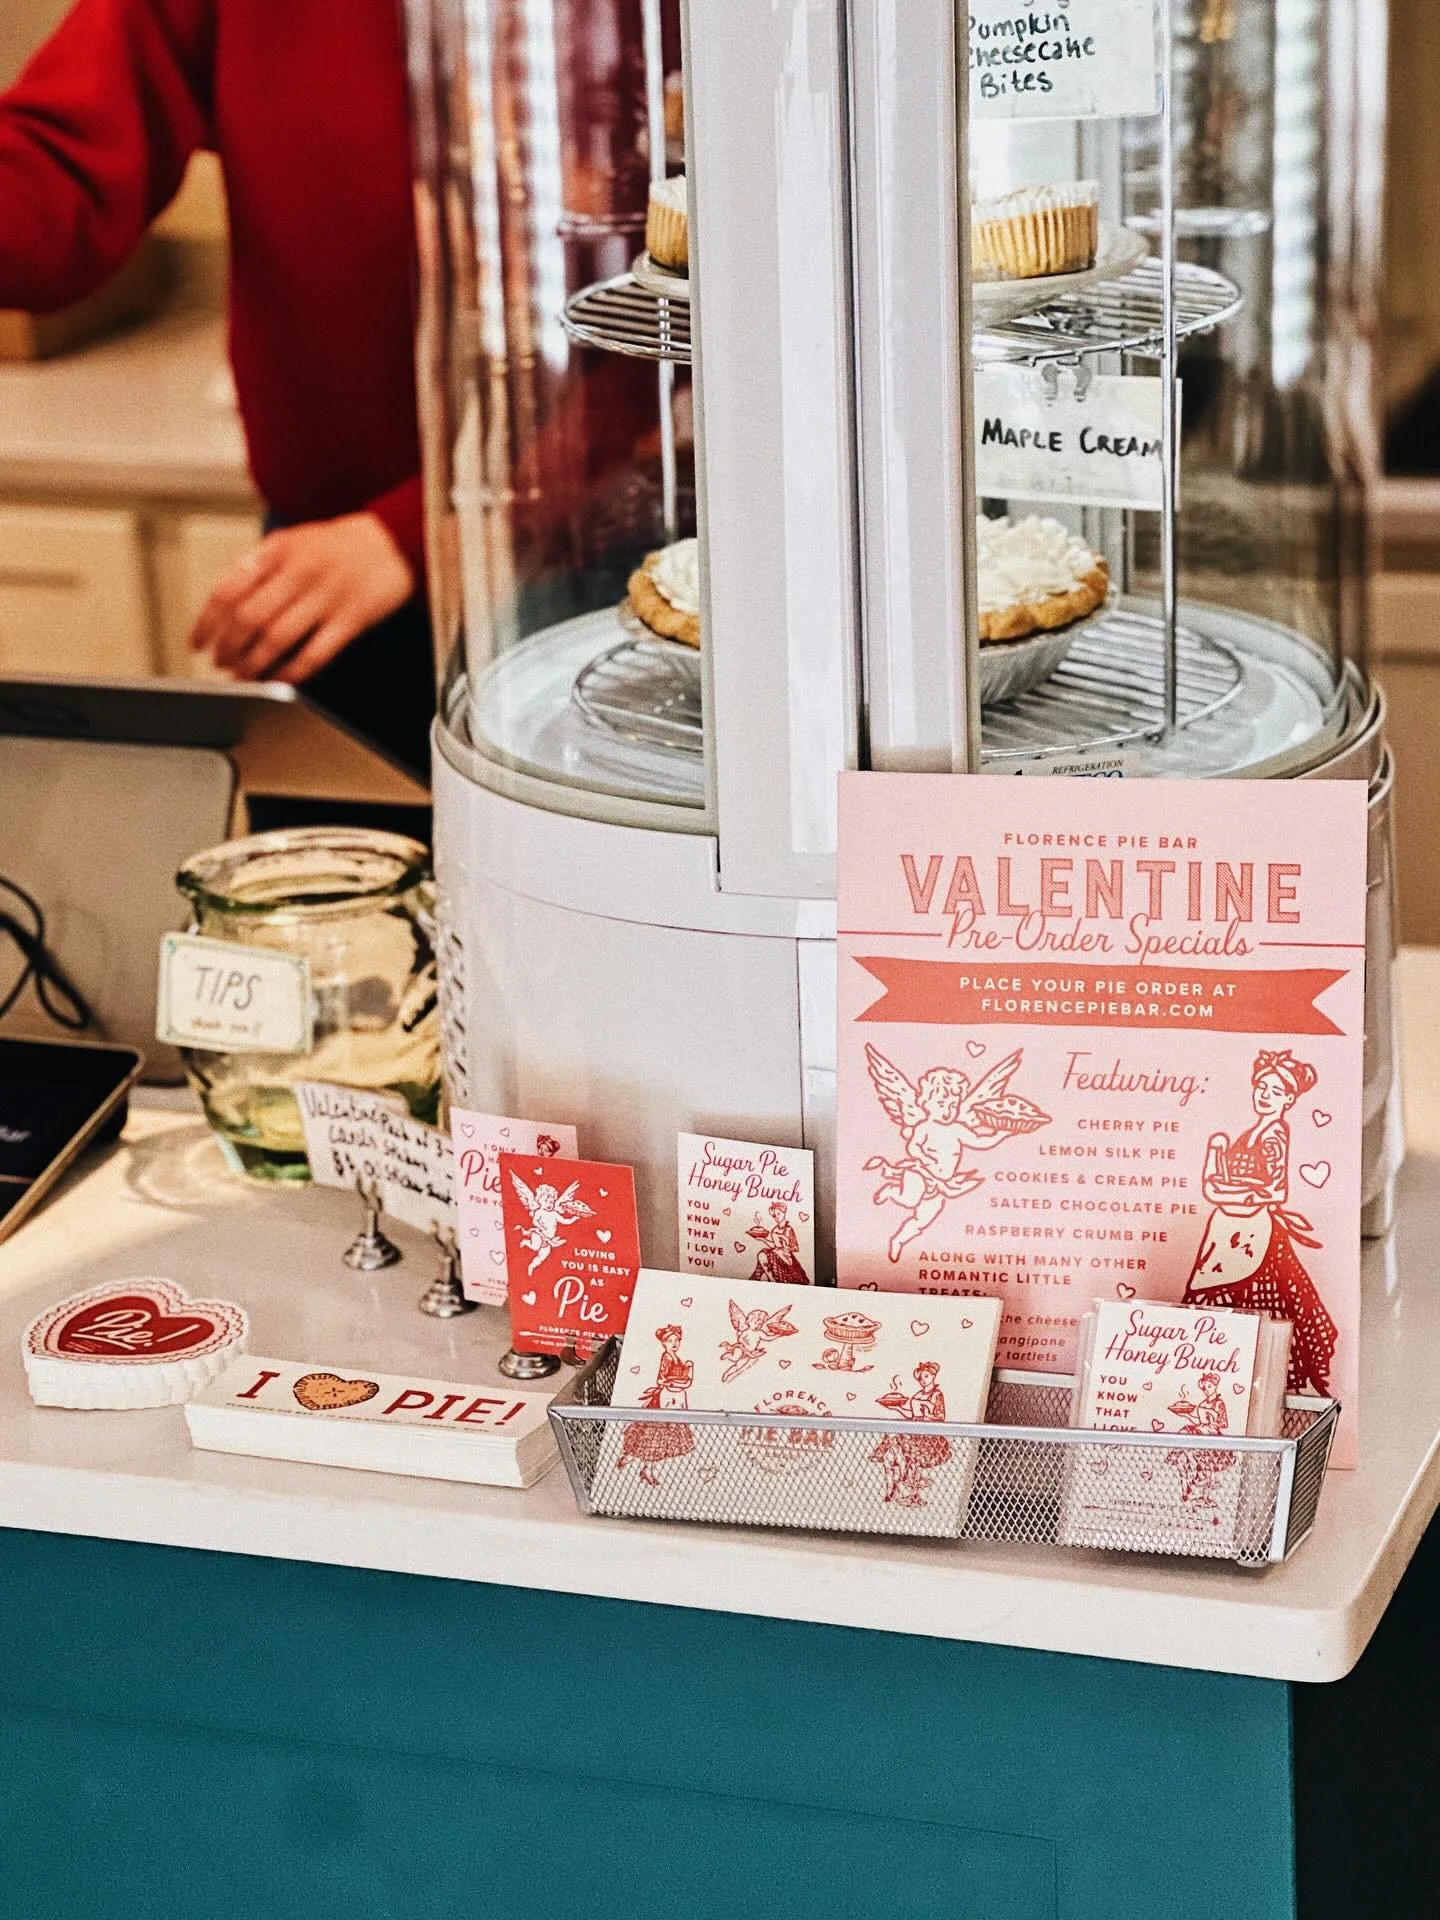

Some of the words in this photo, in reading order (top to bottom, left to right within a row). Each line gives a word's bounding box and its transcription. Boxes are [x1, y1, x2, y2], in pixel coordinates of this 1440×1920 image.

[981, 70, 1053, 98] Bites
[981, 417, 1063, 452] MAPLE
[1079, 426, 1163, 461] CREAM
[1052, 760, 1124, 775] REFRIGERATION
[1004, 833, 1107, 848] FLORENCE
[1118, 835, 1149, 849] PIE
[1159, 836, 1199, 850] BAR
[900, 854, 1301, 924] VALENTINE
[947, 908, 1114, 953] Pre-Order
[1125, 912, 1254, 966] Specials
[196, 965, 261, 1011] TIPS
[959, 976, 1022, 992] PLACE
[1031, 978, 1086, 993] YOUR
[1095, 980, 1126, 994] PIE
[1135, 981, 1203, 996] ORDER
[1212, 983, 1238, 997] AT
[981, 998, 1214, 1017] FLORENCEPIEBAR.COM
[1062, 1051, 1209, 1107] Featuring:
[1077, 1118, 1145, 1131] CHERRY
[1153, 1121, 1180, 1133] PIE
[702, 1141, 755, 1176] Sugar
[759, 1150, 789, 1177] Pie
[1039, 1144, 1097, 1157] LEMON
[1105, 1146, 1142, 1159] SILK
[1150, 1148, 1177, 1160] PIE
[688, 1162, 743, 1201] Honey
[745, 1174, 803, 1203] Bunch
[994, 1171, 1070, 1184] COOKIES
[1077, 1173, 1087, 1185] &
[1094, 1174, 1153, 1187] CREAM
[1161, 1176, 1188, 1188] PIE
[687, 1200, 710, 1210] YOU
[990, 1197, 1053, 1210] SALTED
[1060, 1200, 1163, 1214] CHOCOLATE
[1170, 1203, 1198, 1215] PIE
[687, 1214, 721, 1226] KNOW
[687, 1228, 716, 1240] THAT
[965, 1224, 1065, 1239] RASPBERRY
[1073, 1228, 1134, 1241] CRUMB
[1141, 1231, 1168, 1242] PIE
[574, 1248, 616, 1260] LOVING
[694, 1244, 724, 1256] LOVE
[561, 1260, 584, 1270] YOU
[588, 1264, 599, 1272] IS
[603, 1265, 631, 1277] EASY
[687, 1257, 715, 1268] YOU!
[919, 1251, 976, 1263] ALONG
[984, 1253, 1026, 1265] WITH
[1034, 1256, 1082, 1268] MANY
[1090, 1257, 1147, 1270] OTHER
[590, 1278, 605, 1287] AS
[919, 1269, 1008, 1284] ROMANTIC
[1016, 1272, 1072, 1285] LITTLE
[553, 1275, 609, 1323] Pie
[1027, 1315, 1080, 1326] cheese
[1126, 1309, 1188, 1348] Sugar
[1194, 1315, 1228, 1345] Pie
[1006, 1351, 1058, 1362] tartlets
[1105, 1333, 1170, 1374] Honey
[1174, 1343, 1240, 1373] Bunch
[1100, 1374, 1128, 1386] YOU
[236, 1370, 280, 1398] I
[382, 1389, 526, 1426] PIE!
[1097, 1390, 1138, 1404] KNOW
[1095, 1406, 1131, 1418] THAT
